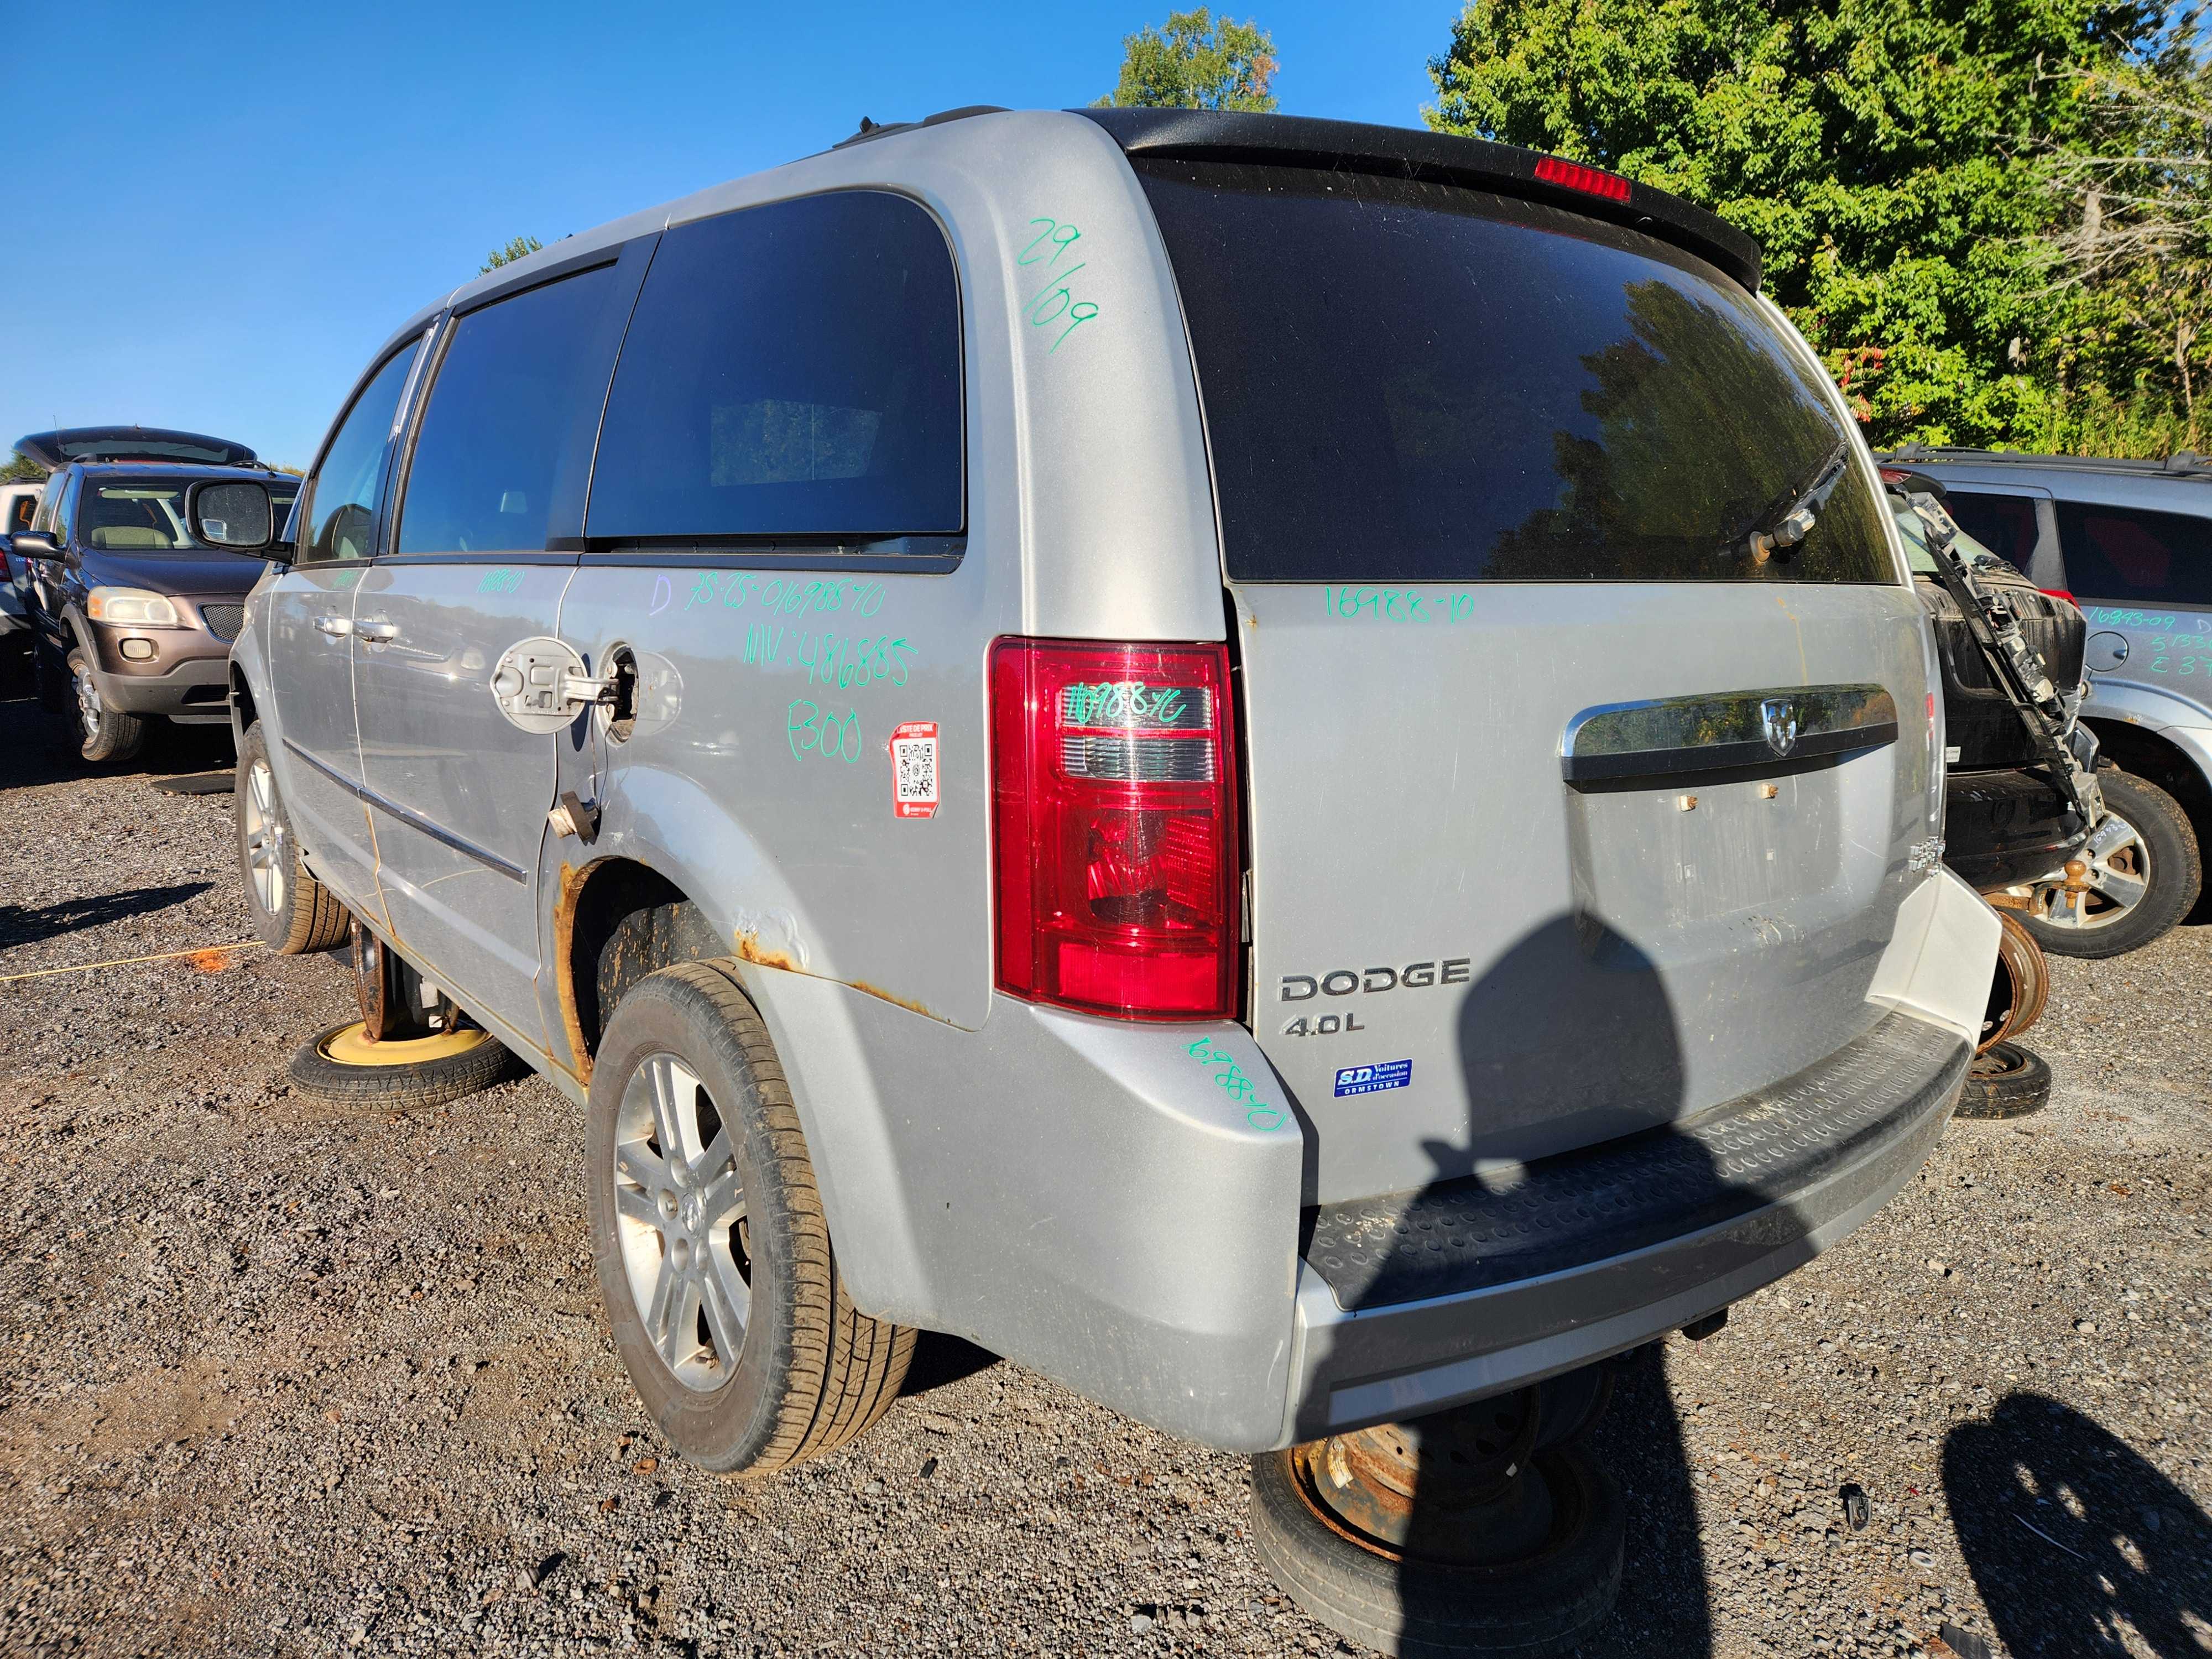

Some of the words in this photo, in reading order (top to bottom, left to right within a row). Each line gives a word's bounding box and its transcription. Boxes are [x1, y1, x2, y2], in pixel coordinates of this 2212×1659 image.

[1325, 586, 1474, 624] 16988-10
[913, 724, 921, 733] DE
[1279, 958, 1471, 1001] DODGE
[1279, 1010, 1365, 1037] 4.0L
[1374, 1062, 1408, 1073] Voitures
[1373, 1070, 1408, 1081] d'occasion
[1344, 1081, 1400, 1095] ORMSTOWN
